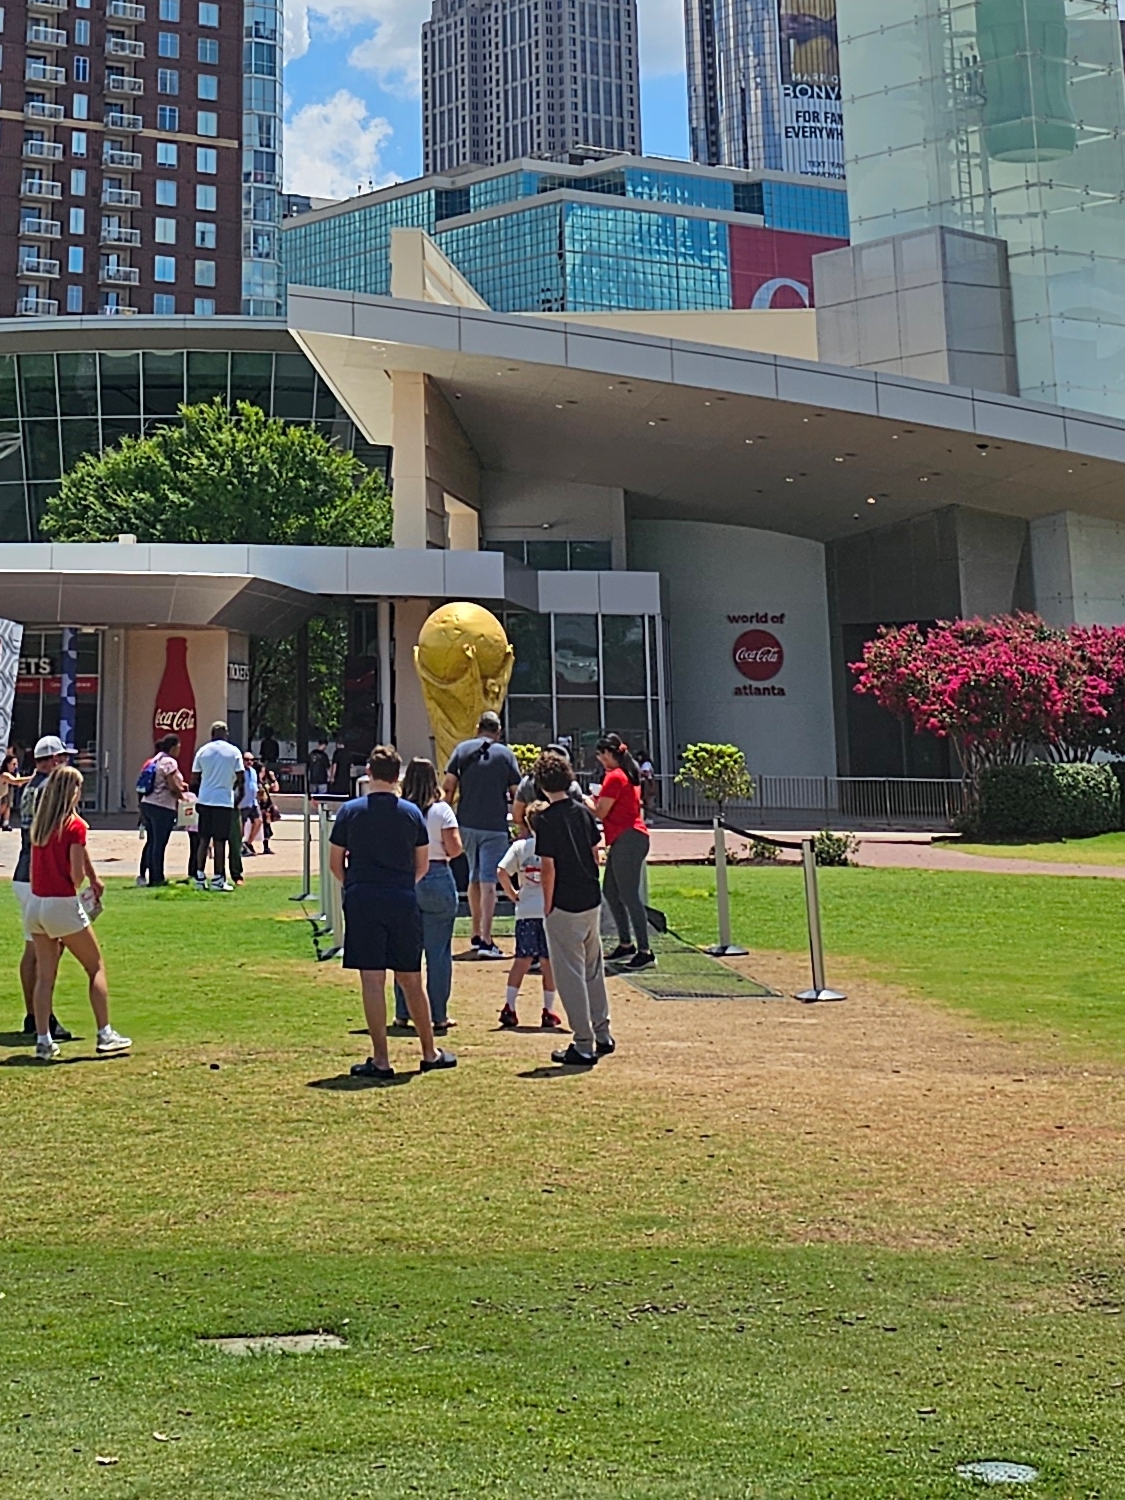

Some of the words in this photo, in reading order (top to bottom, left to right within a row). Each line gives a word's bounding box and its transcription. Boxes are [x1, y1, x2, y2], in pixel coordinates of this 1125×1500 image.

[783, 84, 839, 100] BONV
[796, 110, 820, 123] FOR
[824, 112, 843, 126] FAN
[785, 126, 843, 141] EVERYWH
[727, 612, 768, 624] world
[770, 612, 786, 624] of
[736, 647, 780, 663] Coca-Cola
[734, 684, 786, 696] atlanta
